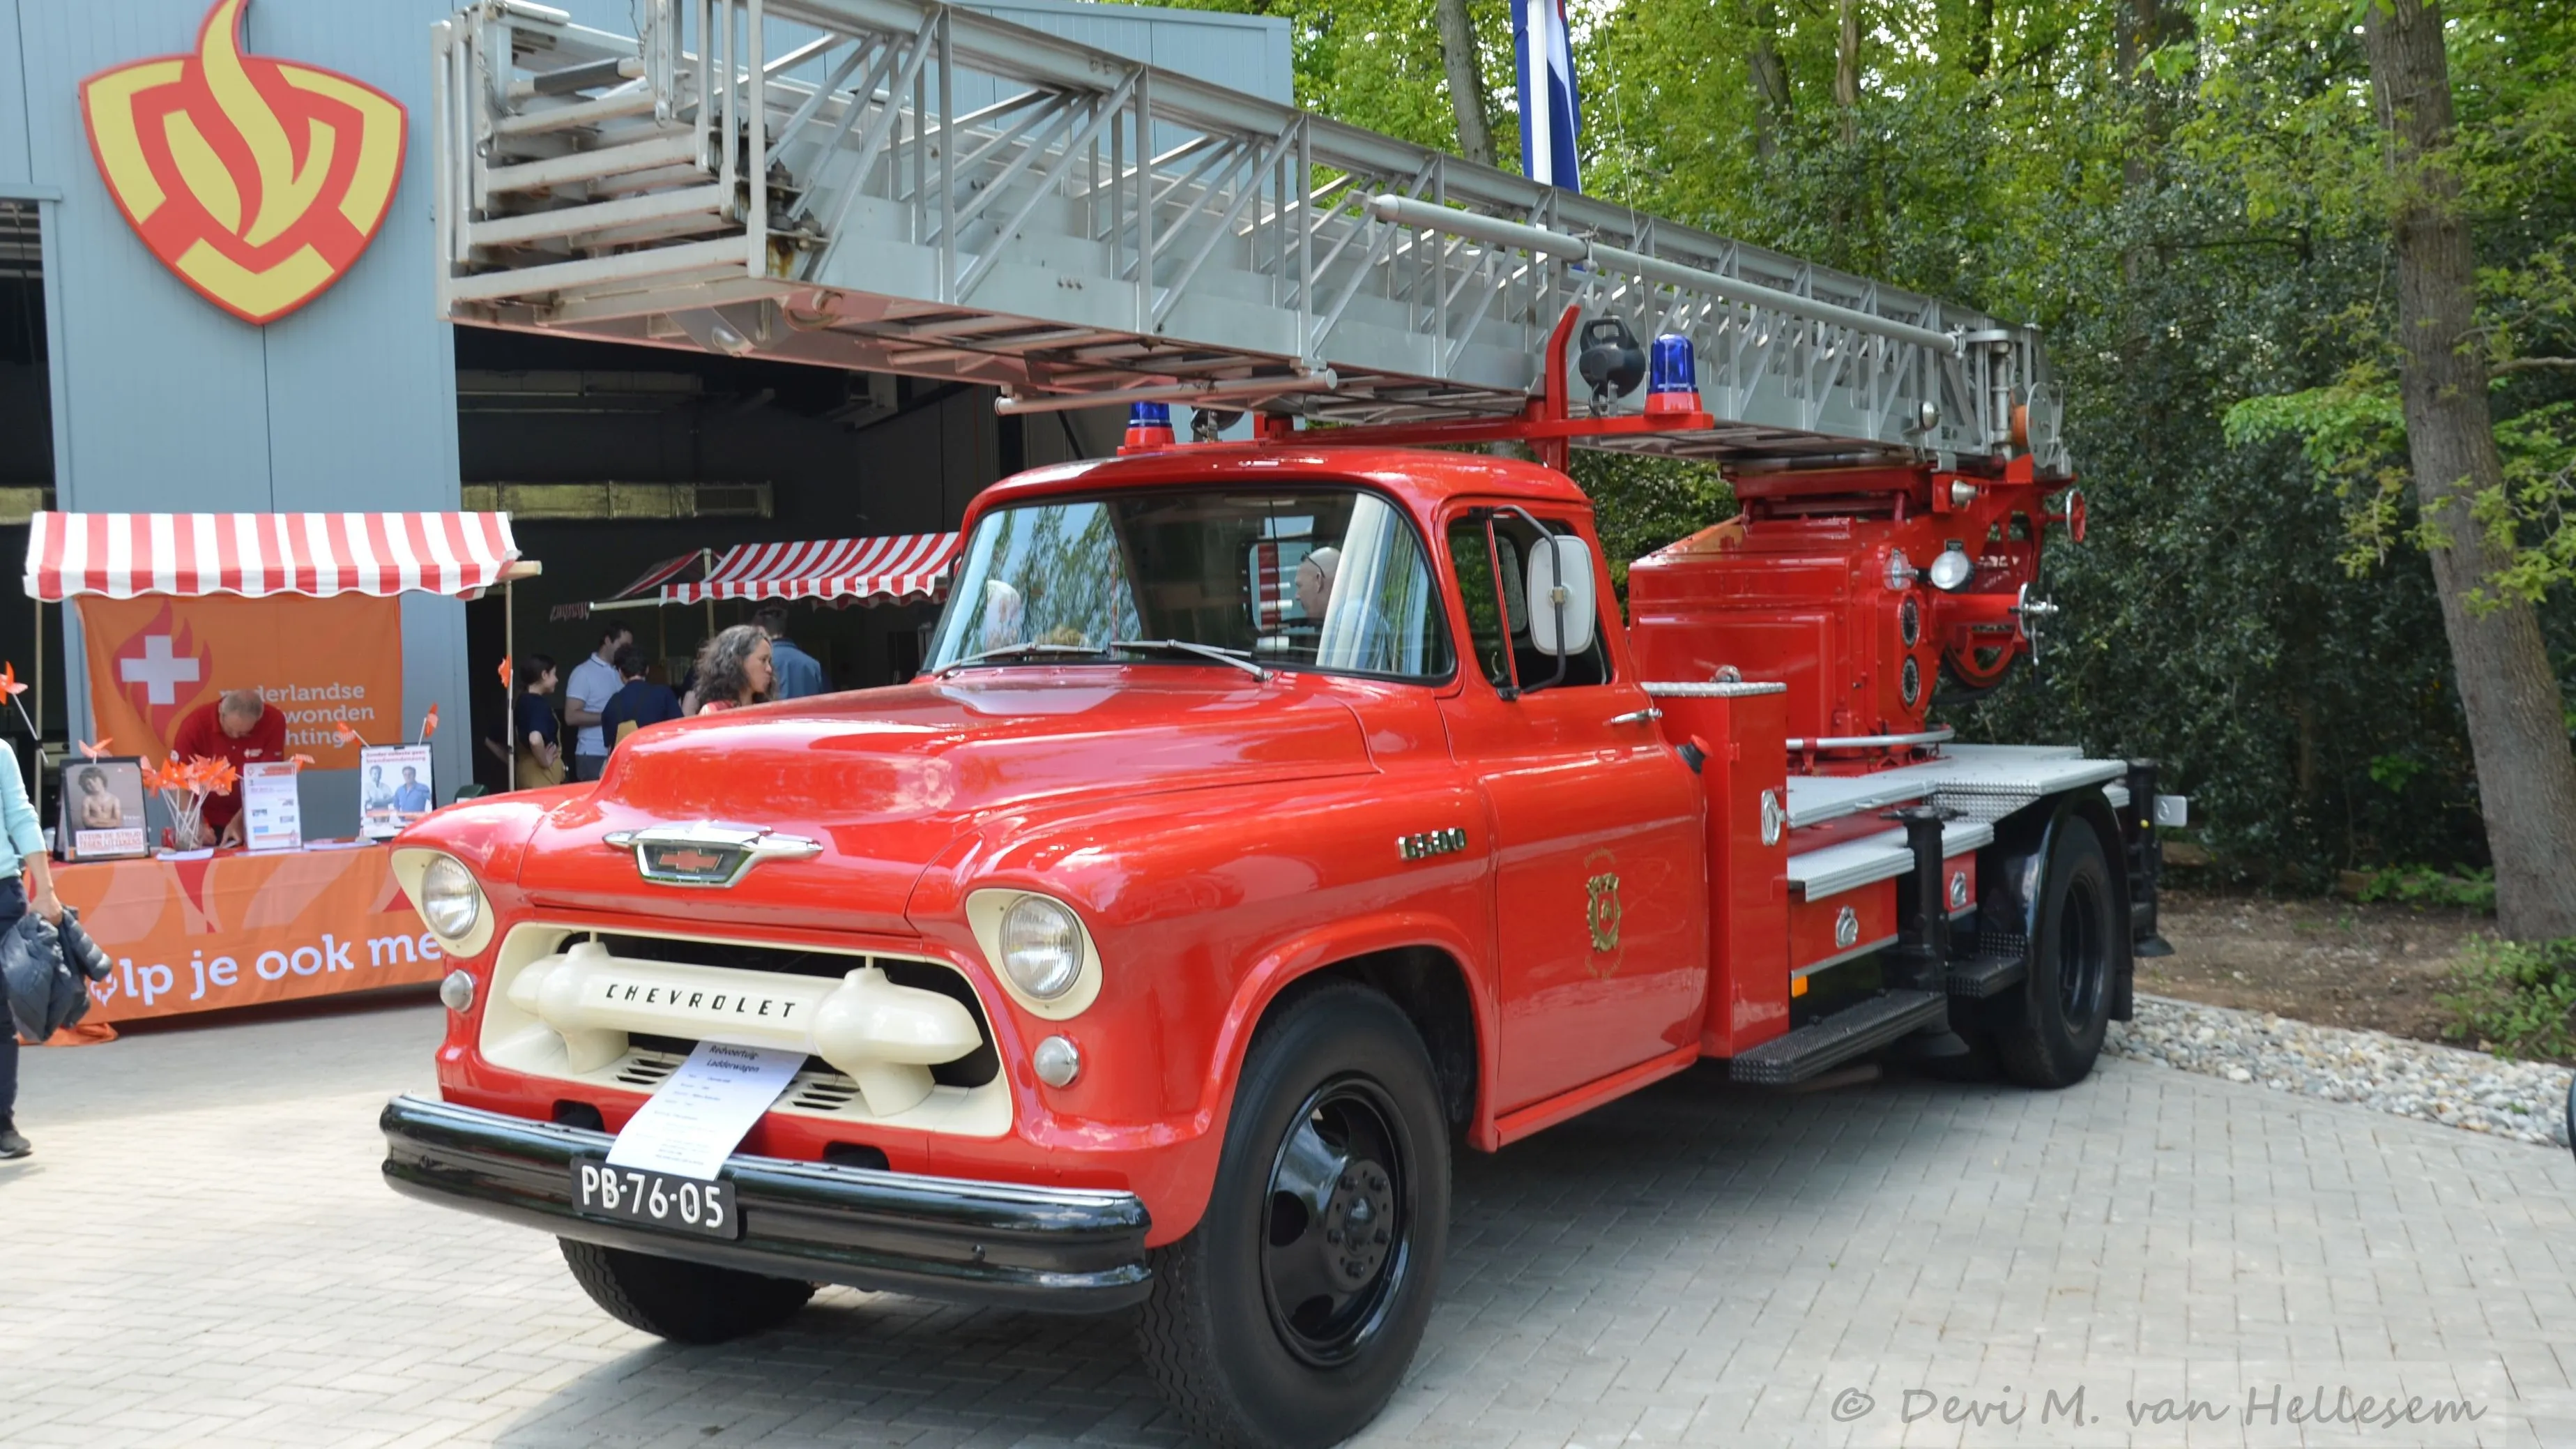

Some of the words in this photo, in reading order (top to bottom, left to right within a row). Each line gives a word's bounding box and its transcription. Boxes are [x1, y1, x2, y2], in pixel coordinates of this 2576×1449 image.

[219, 685, 365, 703] derlandse
[285, 706, 374, 723] wonden
[285, 729, 348, 748] hting
[119, 957, 174, 1006] lp
[190, 950, 238, 1000] je
[256, 934, 353, 981] ook
[367, 932, 441, 967] me
[606, 984, 795, 1017] CHEVROLET
[581, 1164, 724, 1228] PB-76-05
